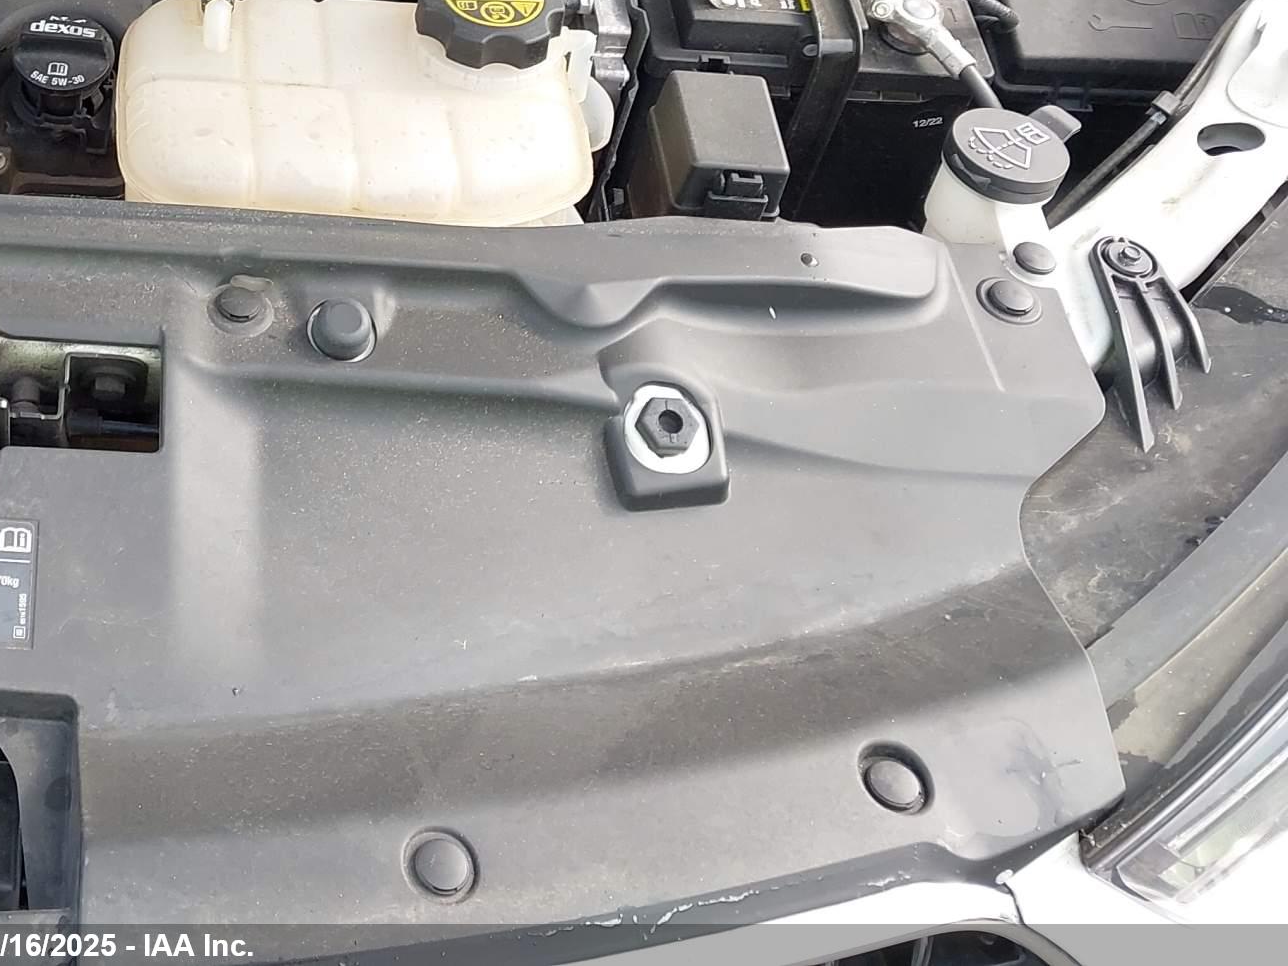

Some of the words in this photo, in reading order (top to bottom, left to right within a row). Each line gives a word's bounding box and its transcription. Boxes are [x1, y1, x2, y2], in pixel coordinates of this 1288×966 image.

[30, 19, 98, 38] dexos
[30, 70, 50, 84] SAE
[51, 74, 85, 86] 5W-30
[912, 116, 943, 128] 12/22
